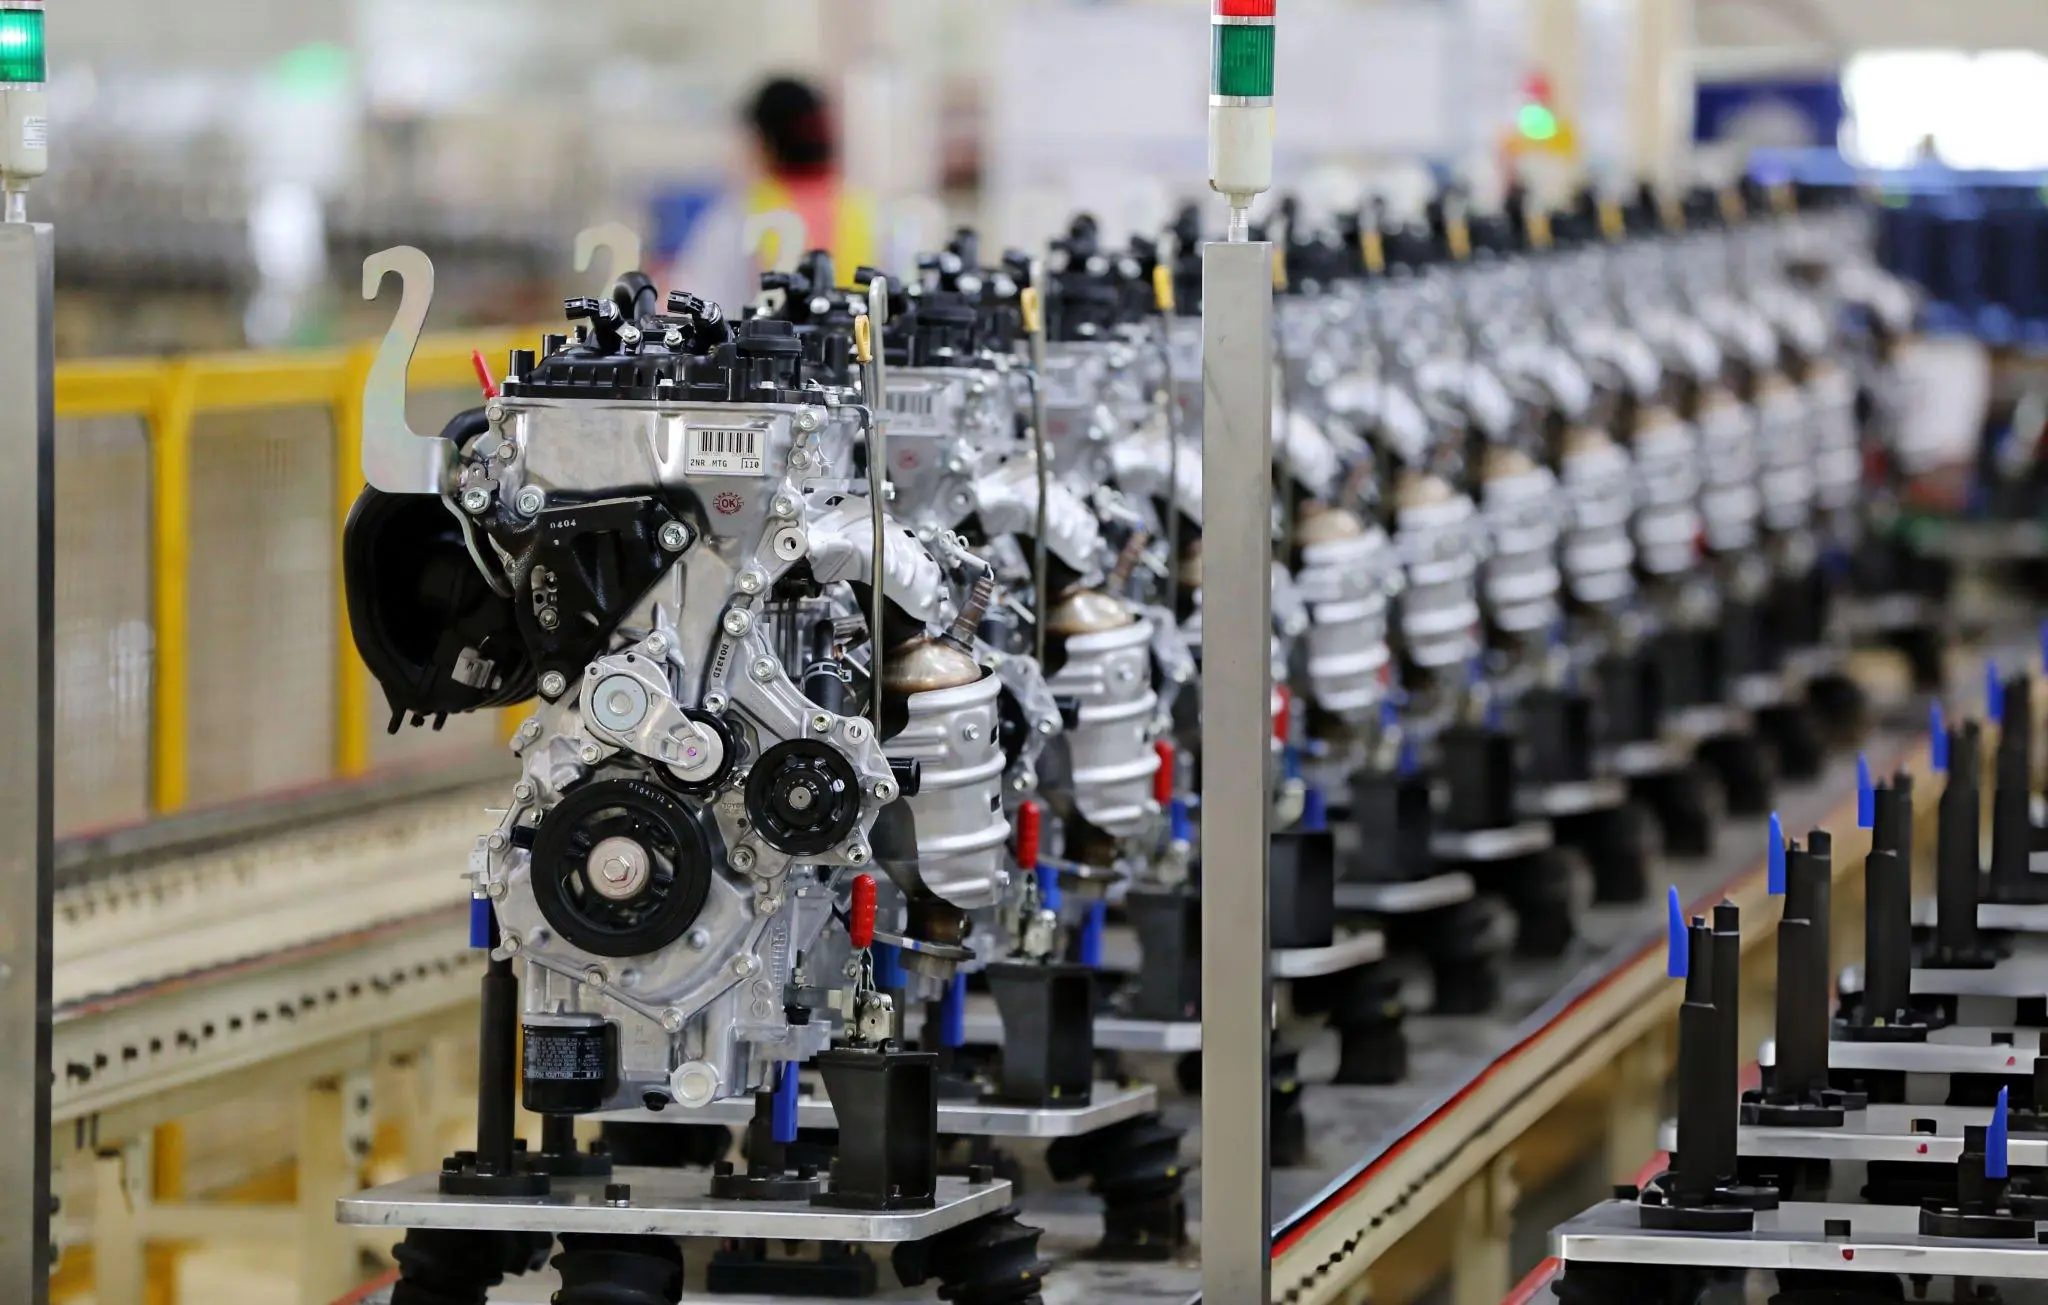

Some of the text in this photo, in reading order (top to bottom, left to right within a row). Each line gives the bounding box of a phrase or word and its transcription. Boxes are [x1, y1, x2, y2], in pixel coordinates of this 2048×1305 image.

[690, 459, 728, 468] 2NR MTG
[745, 461, 760, 469] 110
[721, 498, 736, 508] OK
